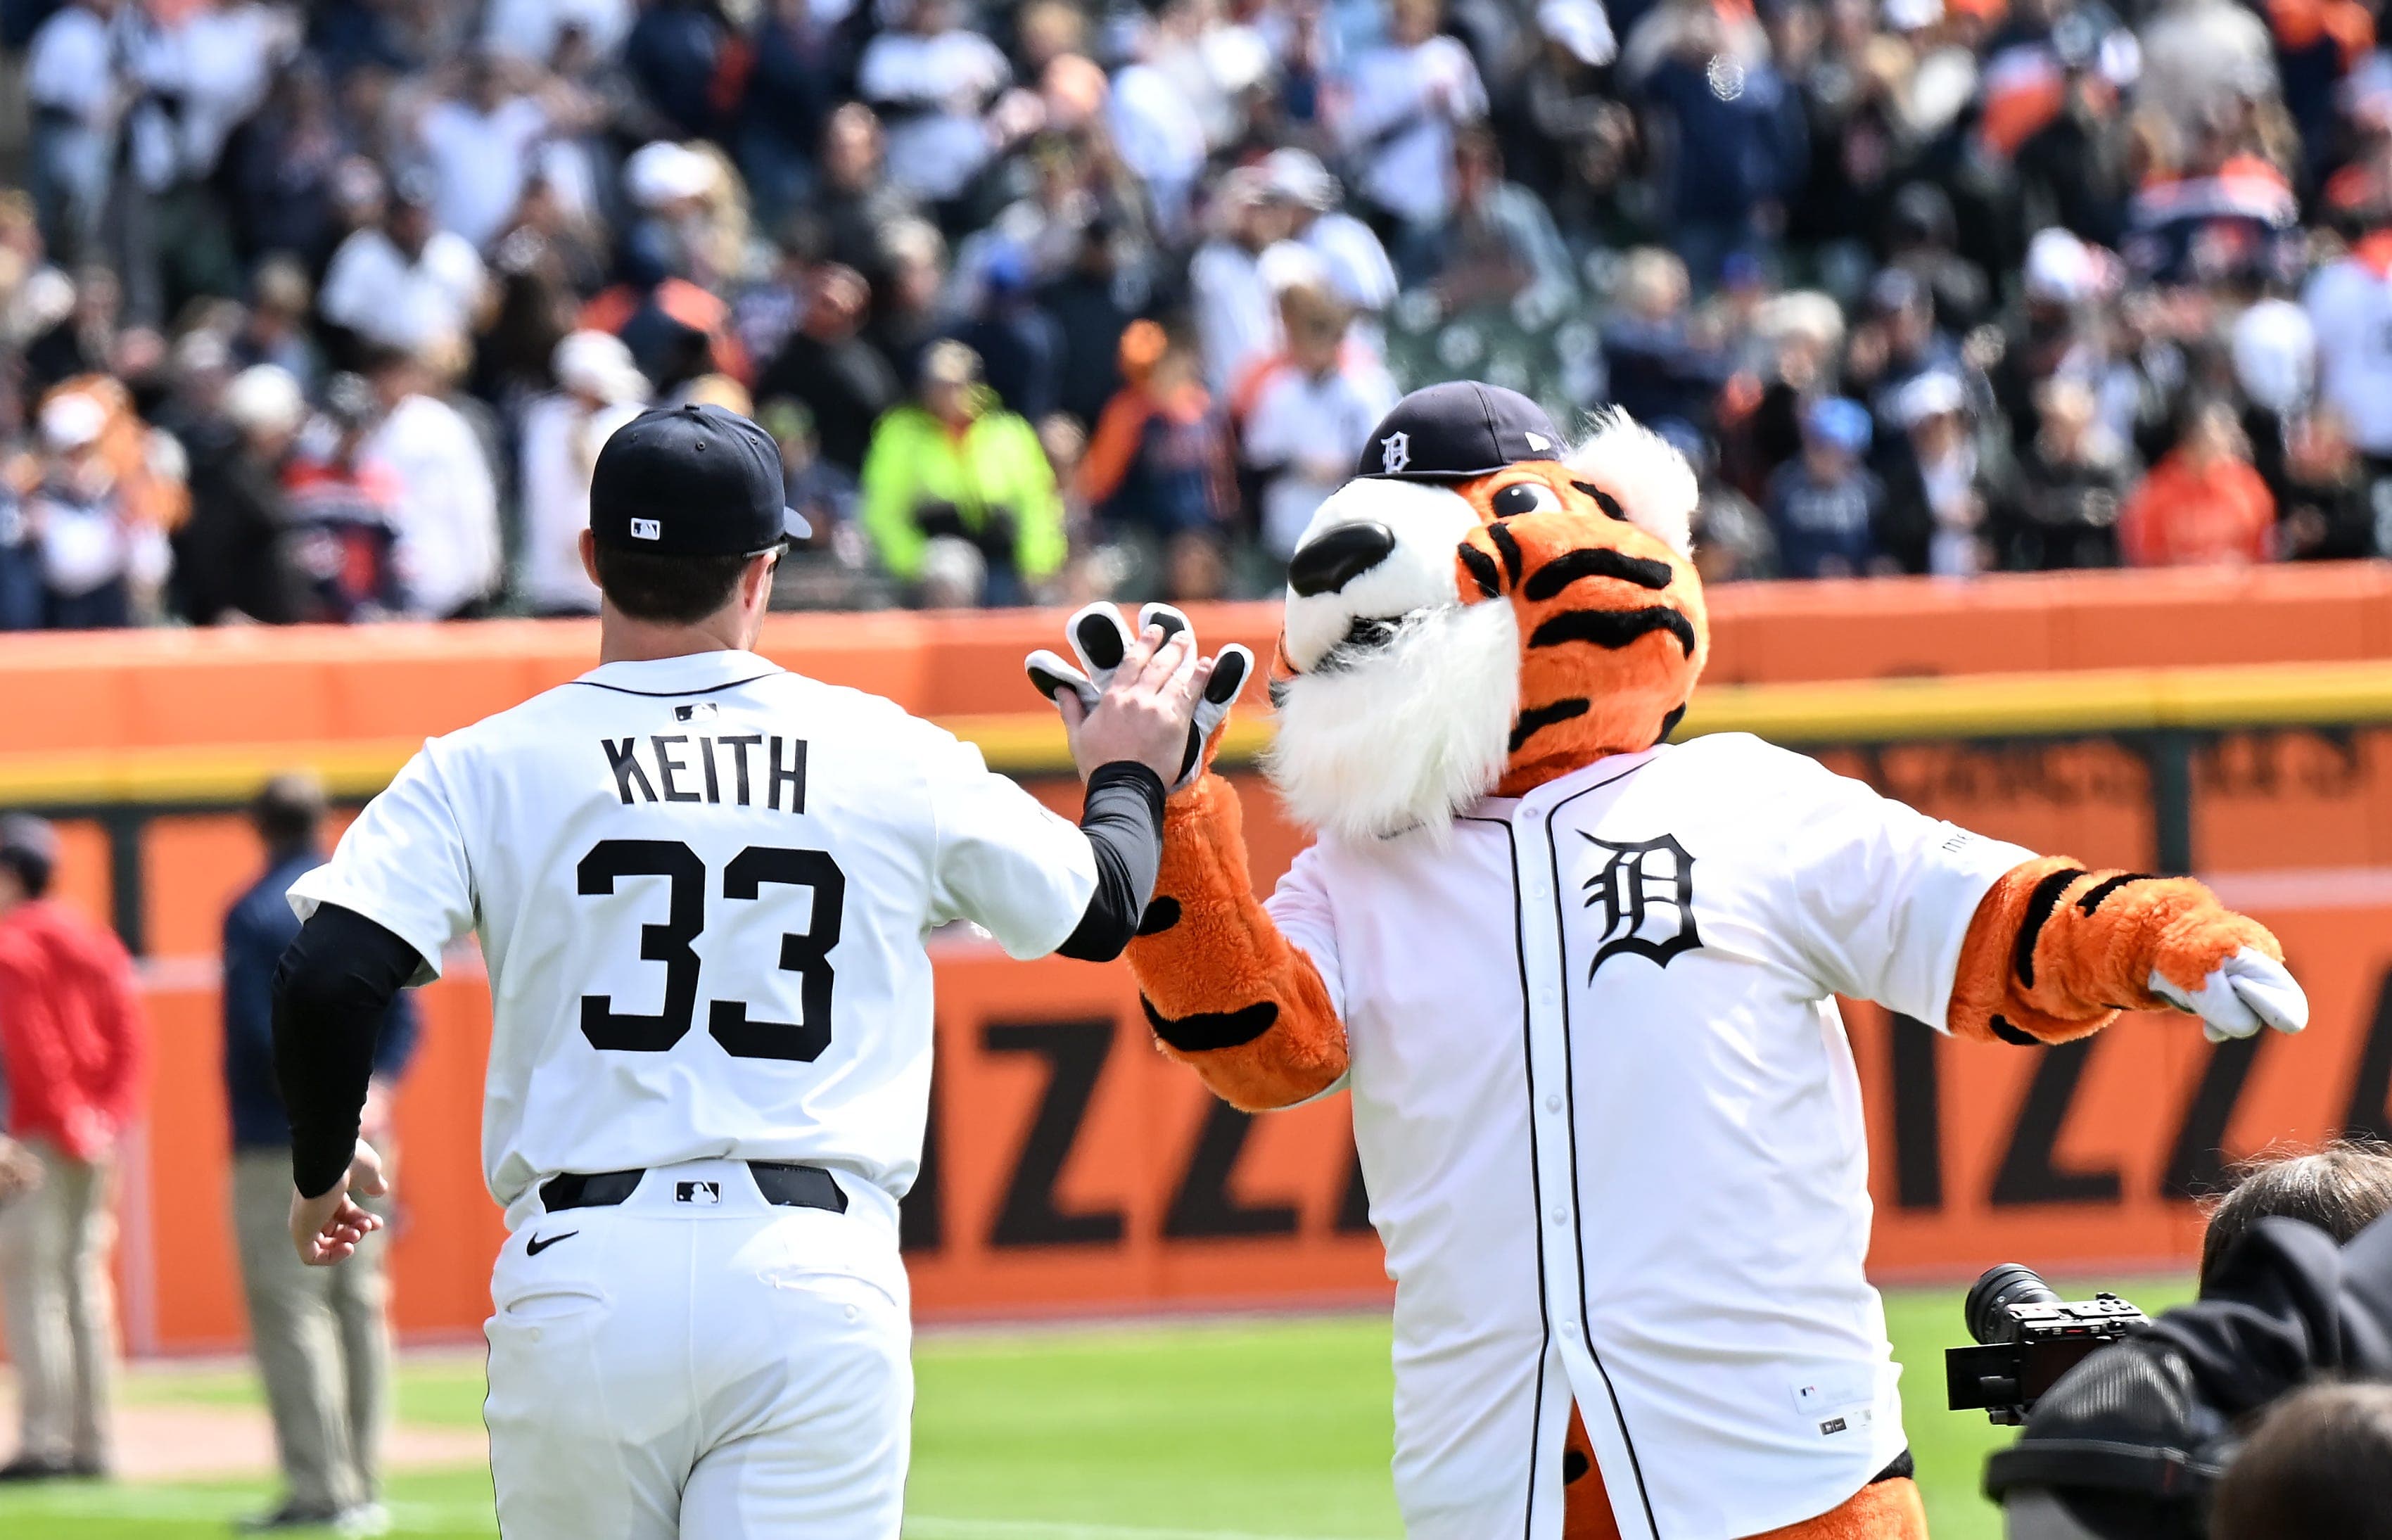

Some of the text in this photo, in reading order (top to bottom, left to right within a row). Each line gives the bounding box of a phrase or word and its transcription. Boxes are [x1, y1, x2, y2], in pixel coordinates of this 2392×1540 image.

[1380, 431, 1412, 474] D
[601, 735, 808, 815] KEITH
[577, 840, 846, 1063] 33
[1574, 832, 1705, 989] D
